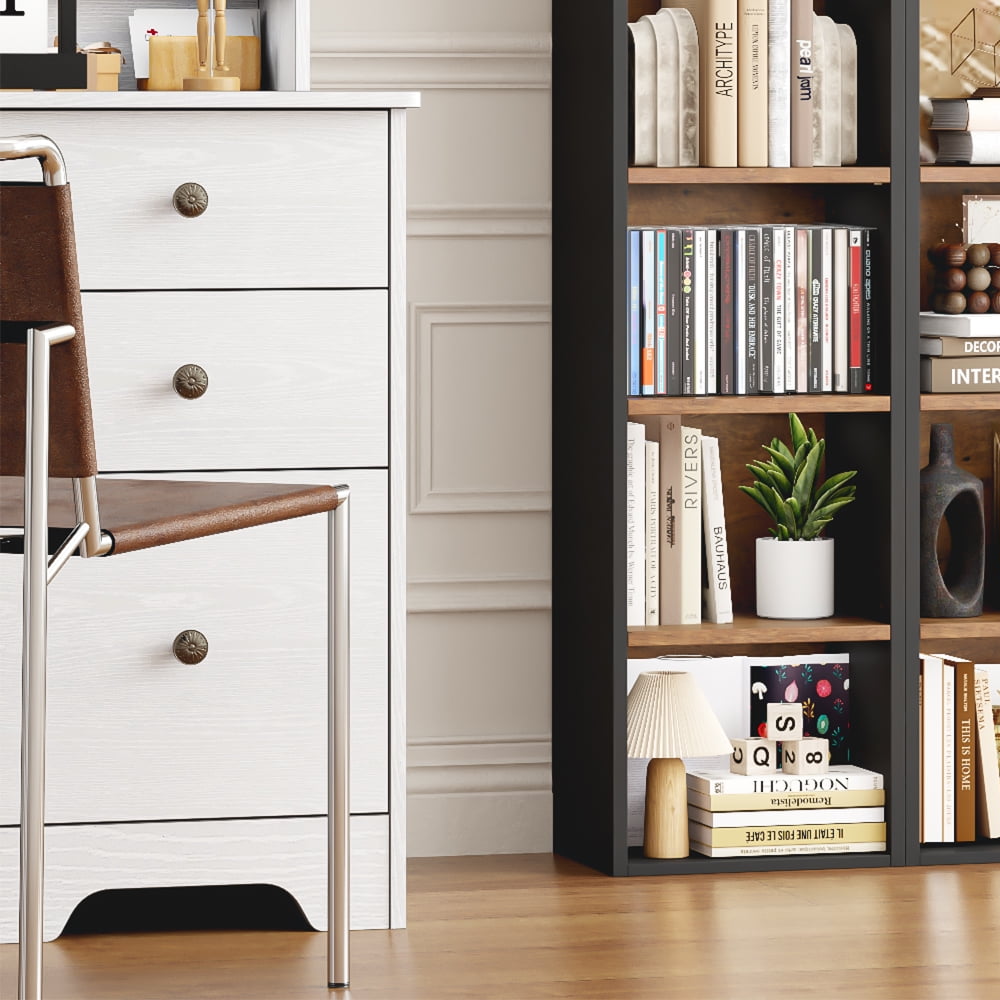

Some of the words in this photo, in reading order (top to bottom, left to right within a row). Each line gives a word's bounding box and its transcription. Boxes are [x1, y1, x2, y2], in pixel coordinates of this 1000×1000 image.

[715, 22, 733, 97] ARCHITYPE
[796, 39, 813, 74] pearl
[748, 303, 756, 315] AND
[748, 317, 756, 328] HER
[628, 451, 636, 477] graphic
[684, 433, 698, 510] RIVERS
[713, 526, 728, 590] BAUHAUS
[981, 678, 991, 705] PAUL
[775, 715, 796, 732] S
[961, 718, 971, 743] THIS
[753, 746, 770, 767] Q
[805, 751, 823, 764] 8
[961, 746, 971, 756] IS
[961, 758, 971, 791] HOME
[753, 777, 849, 793] NOGUCHI
[770, 796, 832, 806] Remodelista
[745, 831, 765, 843] CAFÉ
[767, 830, 776, 841] LE
[778, 830, 795, 840] FOIS
[797, 829, 812, 840] UNE
[814, 828, 835, 841] ÉTAIT
[836, 828, 844, 839] IL
